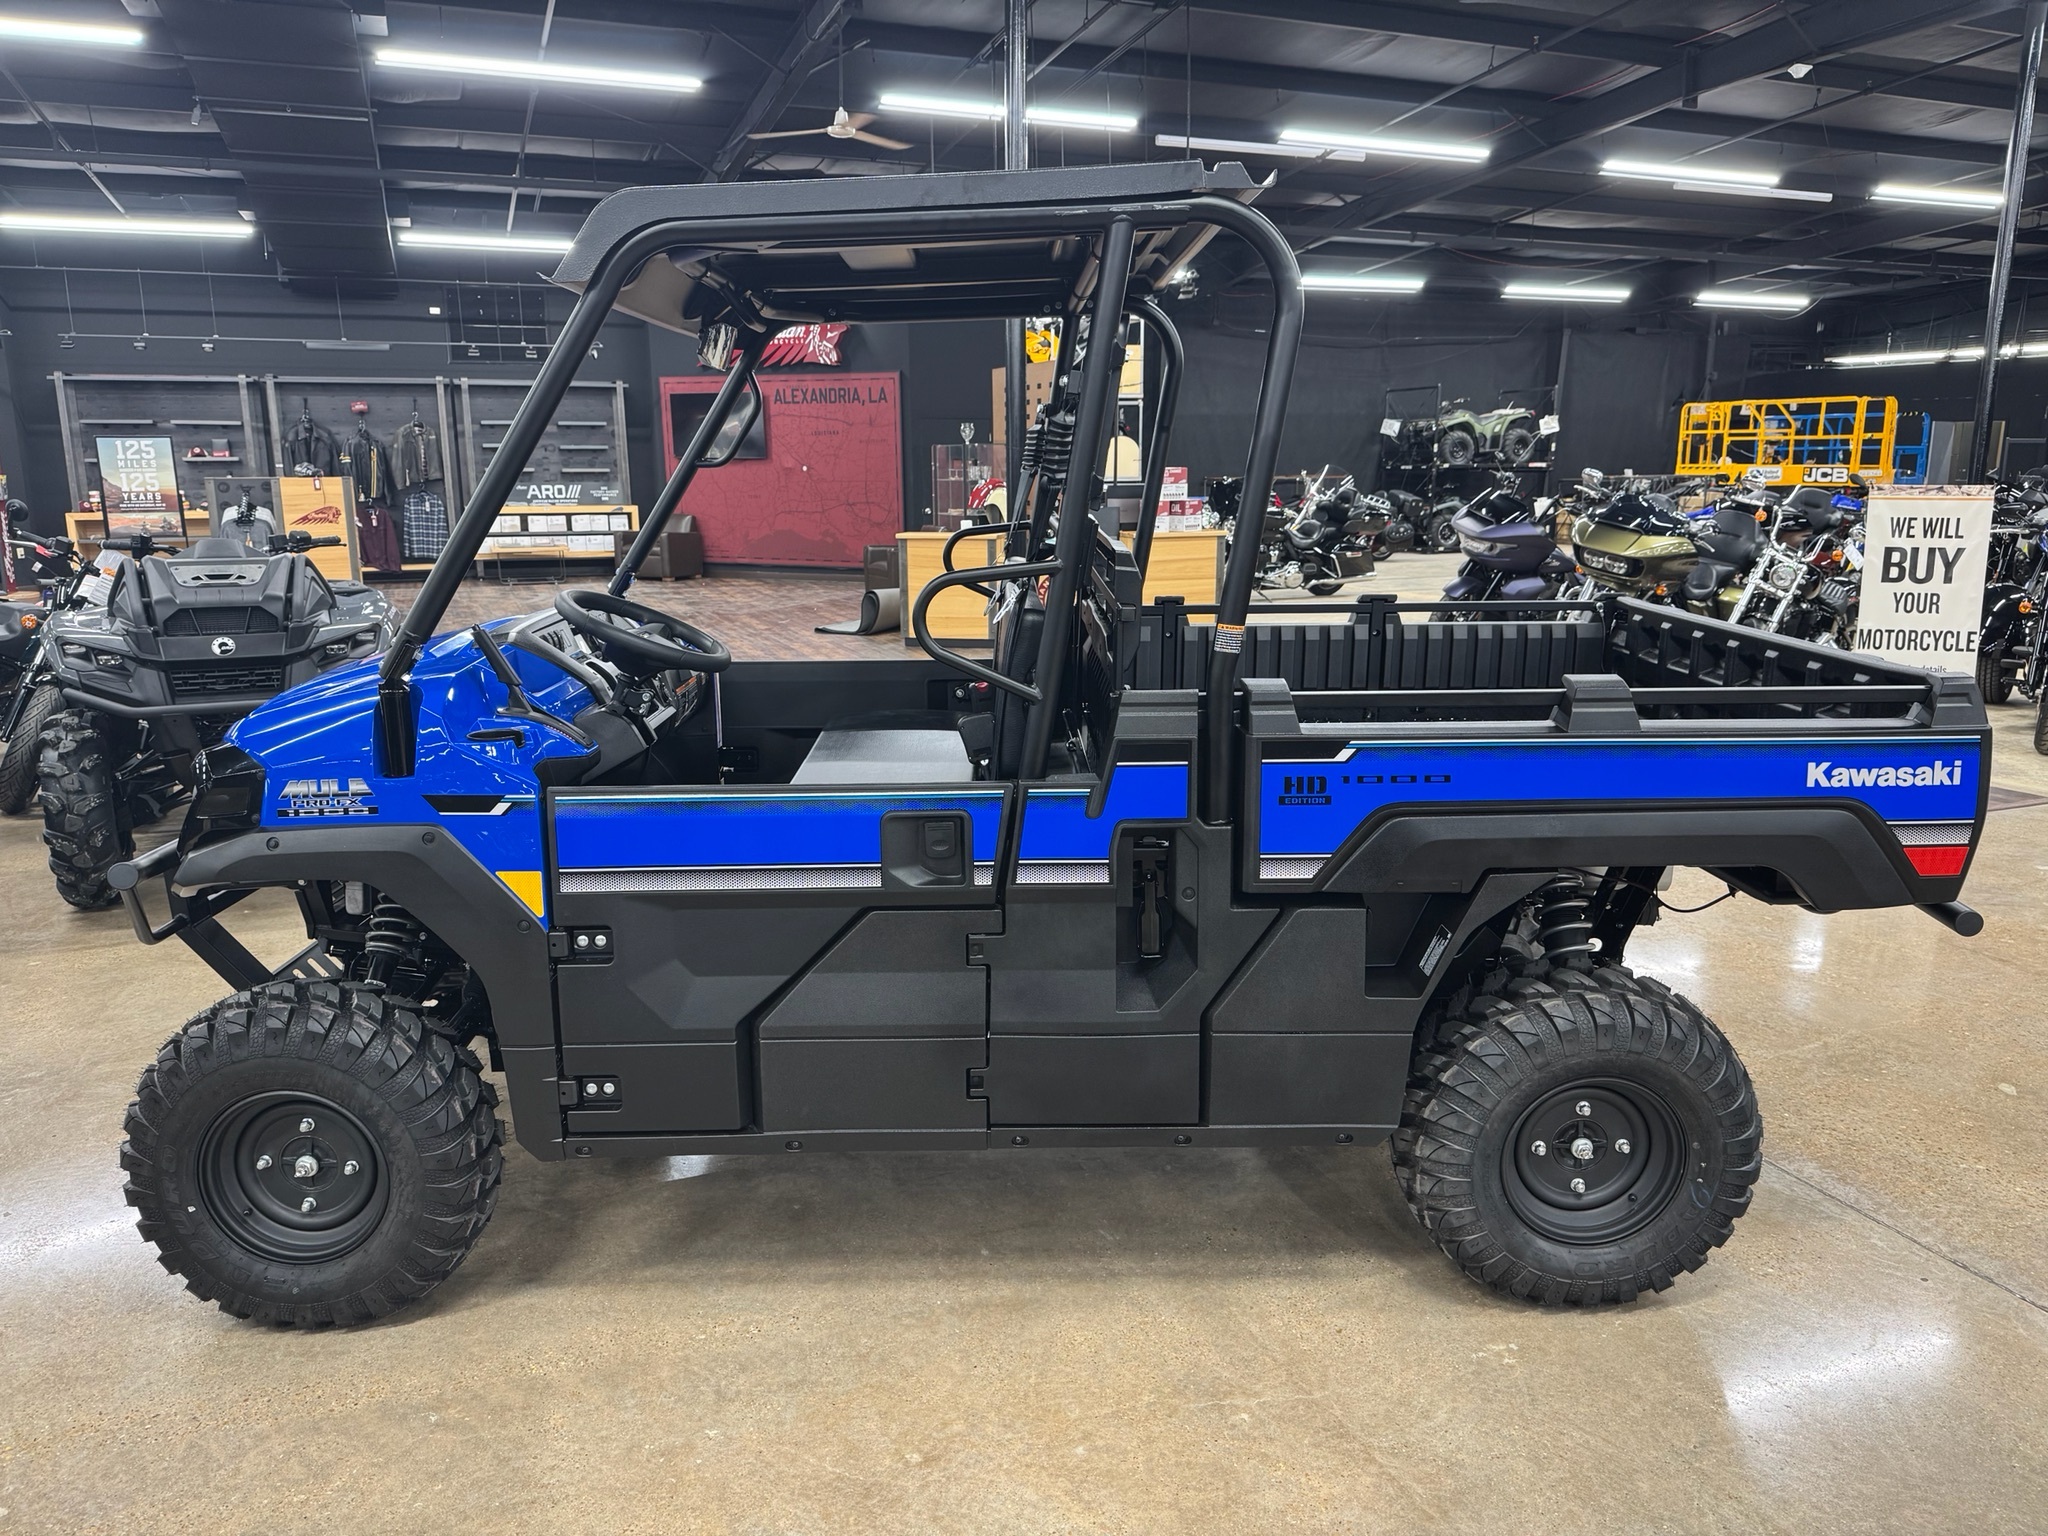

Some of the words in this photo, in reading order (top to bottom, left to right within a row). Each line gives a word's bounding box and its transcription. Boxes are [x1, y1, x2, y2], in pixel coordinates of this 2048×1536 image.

[774, 386, 866, 406] ALEXANDRIA,
[868, 387, 888, 404] LA
[115, 440, 156, 459] 125
[118, 460, 157, 468] MILES
[120, 472, 160, 492] 125
[1803, 467, 1849, 483] JCB
[122, 492, 162, 501] YEARS
[1170, 503, 1182, 513] OIL
[1890, 517, 1918, 538] WE
[1923, 517, 1964, 539] WILL
[1880, 546, 1966, 585] BUY
[1893, 592, 1941, 614] YOUR
[1858, 628, 1978, 653] MOTORCYCLE
[1806, 760, 1963, 788] Kawasaki
[278, 778, 376, 800] MULE
[1284, 776, 1328, 795] HD
[1341, 775, 1452, 784] 1000
[286, 807, 370, 817] 1000
